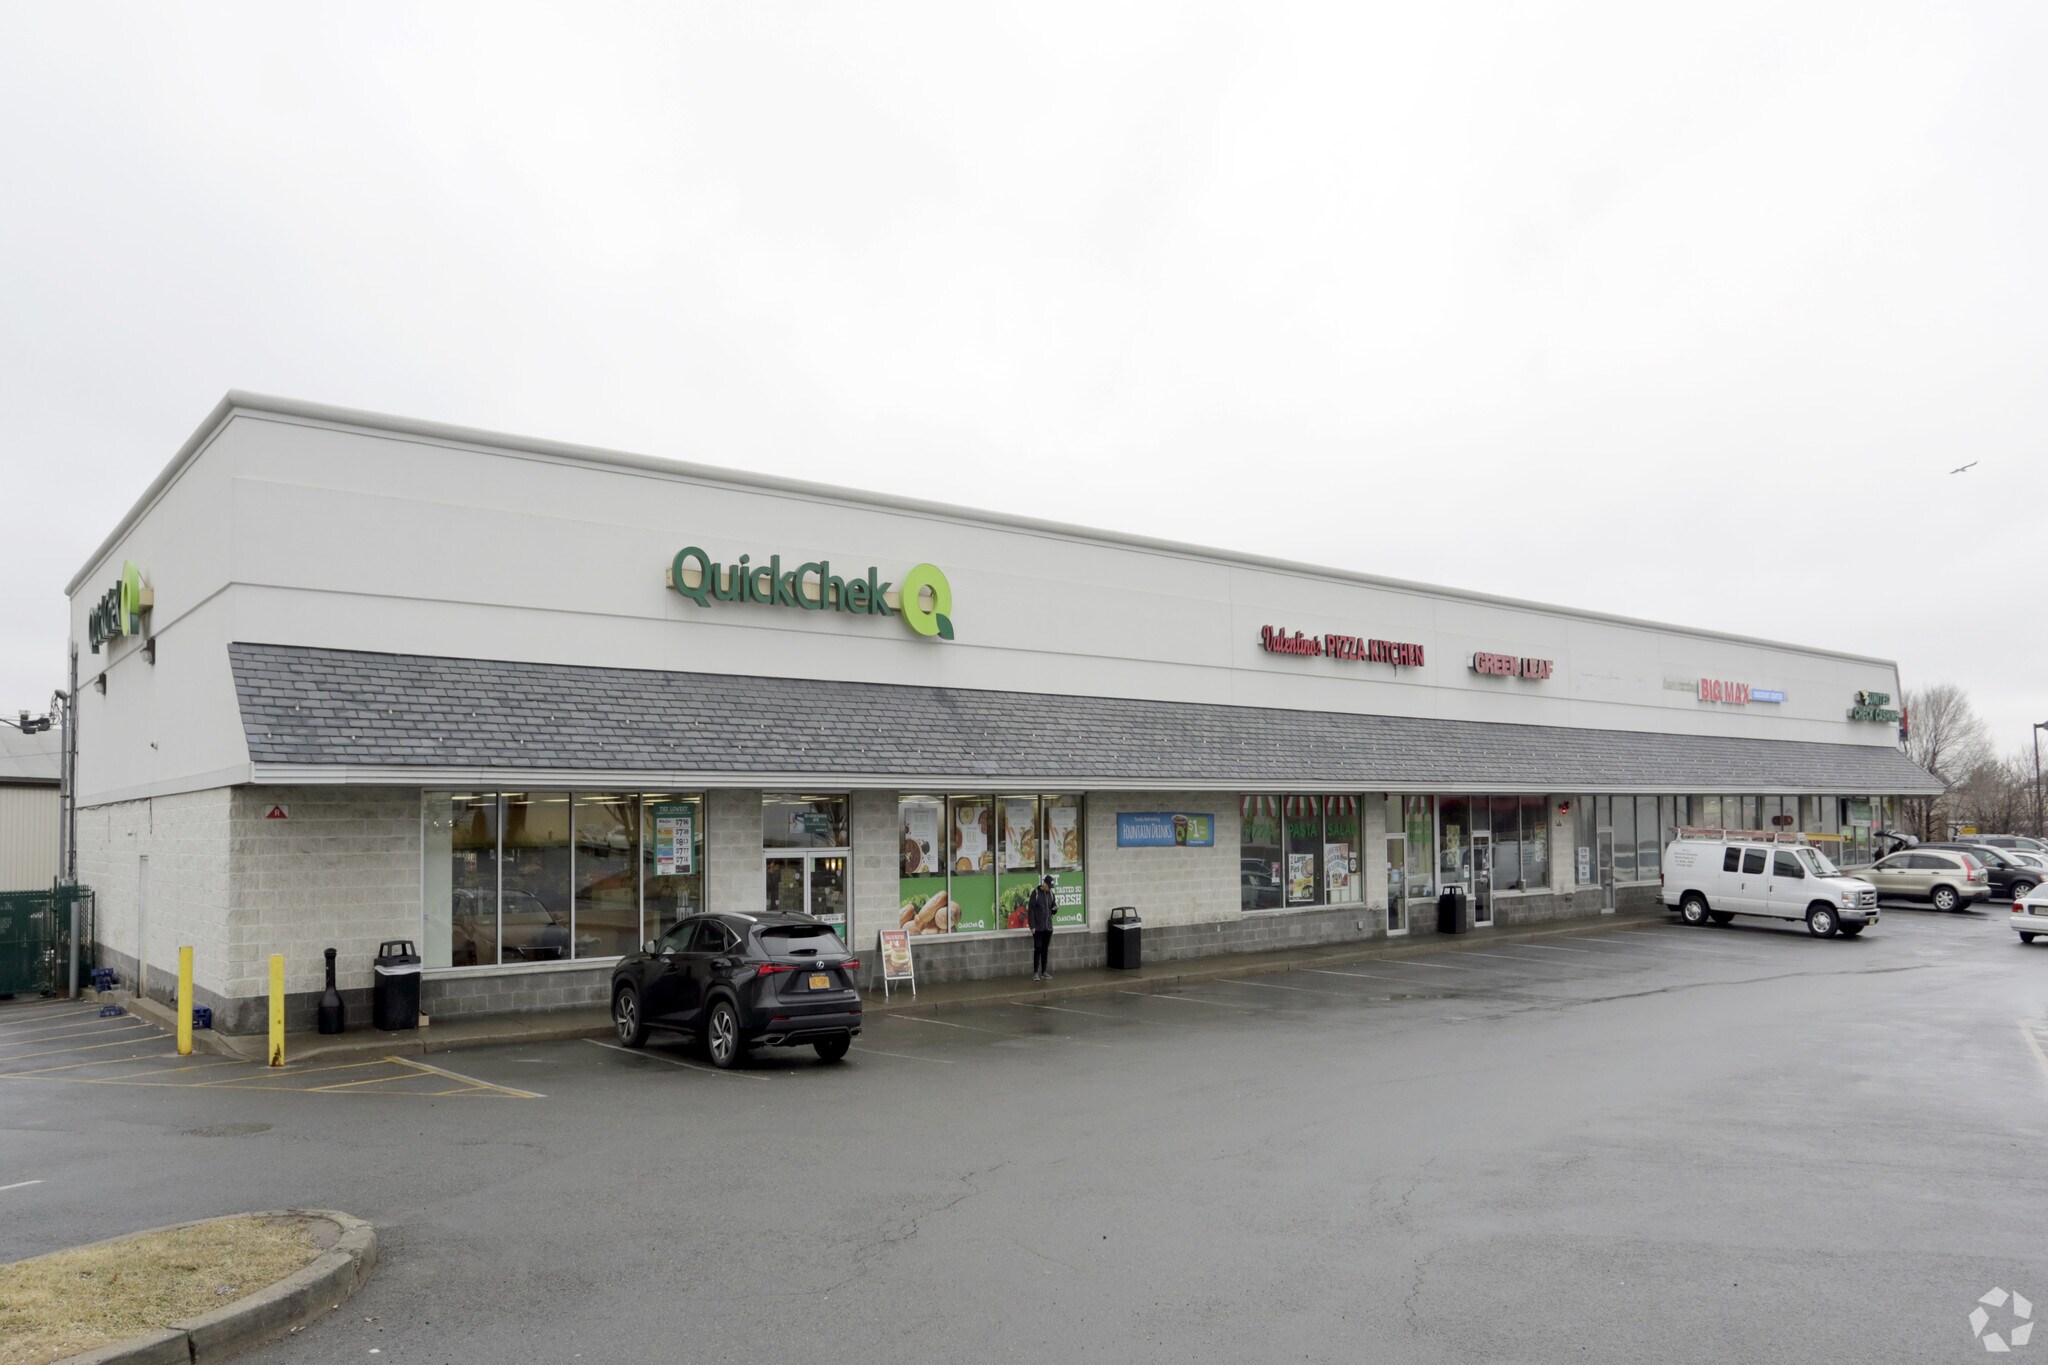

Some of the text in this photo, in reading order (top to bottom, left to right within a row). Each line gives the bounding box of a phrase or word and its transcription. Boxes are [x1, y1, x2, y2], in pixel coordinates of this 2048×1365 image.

[672, 546, 895, 617] QuickChek
[1262, 625, 1424, 667] Valentino's PIZZA KITCHEN
[1473, 651, 1553, 679] GREEN LEAF
[1699, 678, 1751, 704] BIG MAX
[1868, 692, 1890, 705] UNITED
[1852, 707, 1874, 720] CHECK
[1123, 823, 1173, 839] FOUNTAIN DRINKS
[1288, 823, 1318, 838] PASTA
[1055, 894, 1082, 905] FRESH
